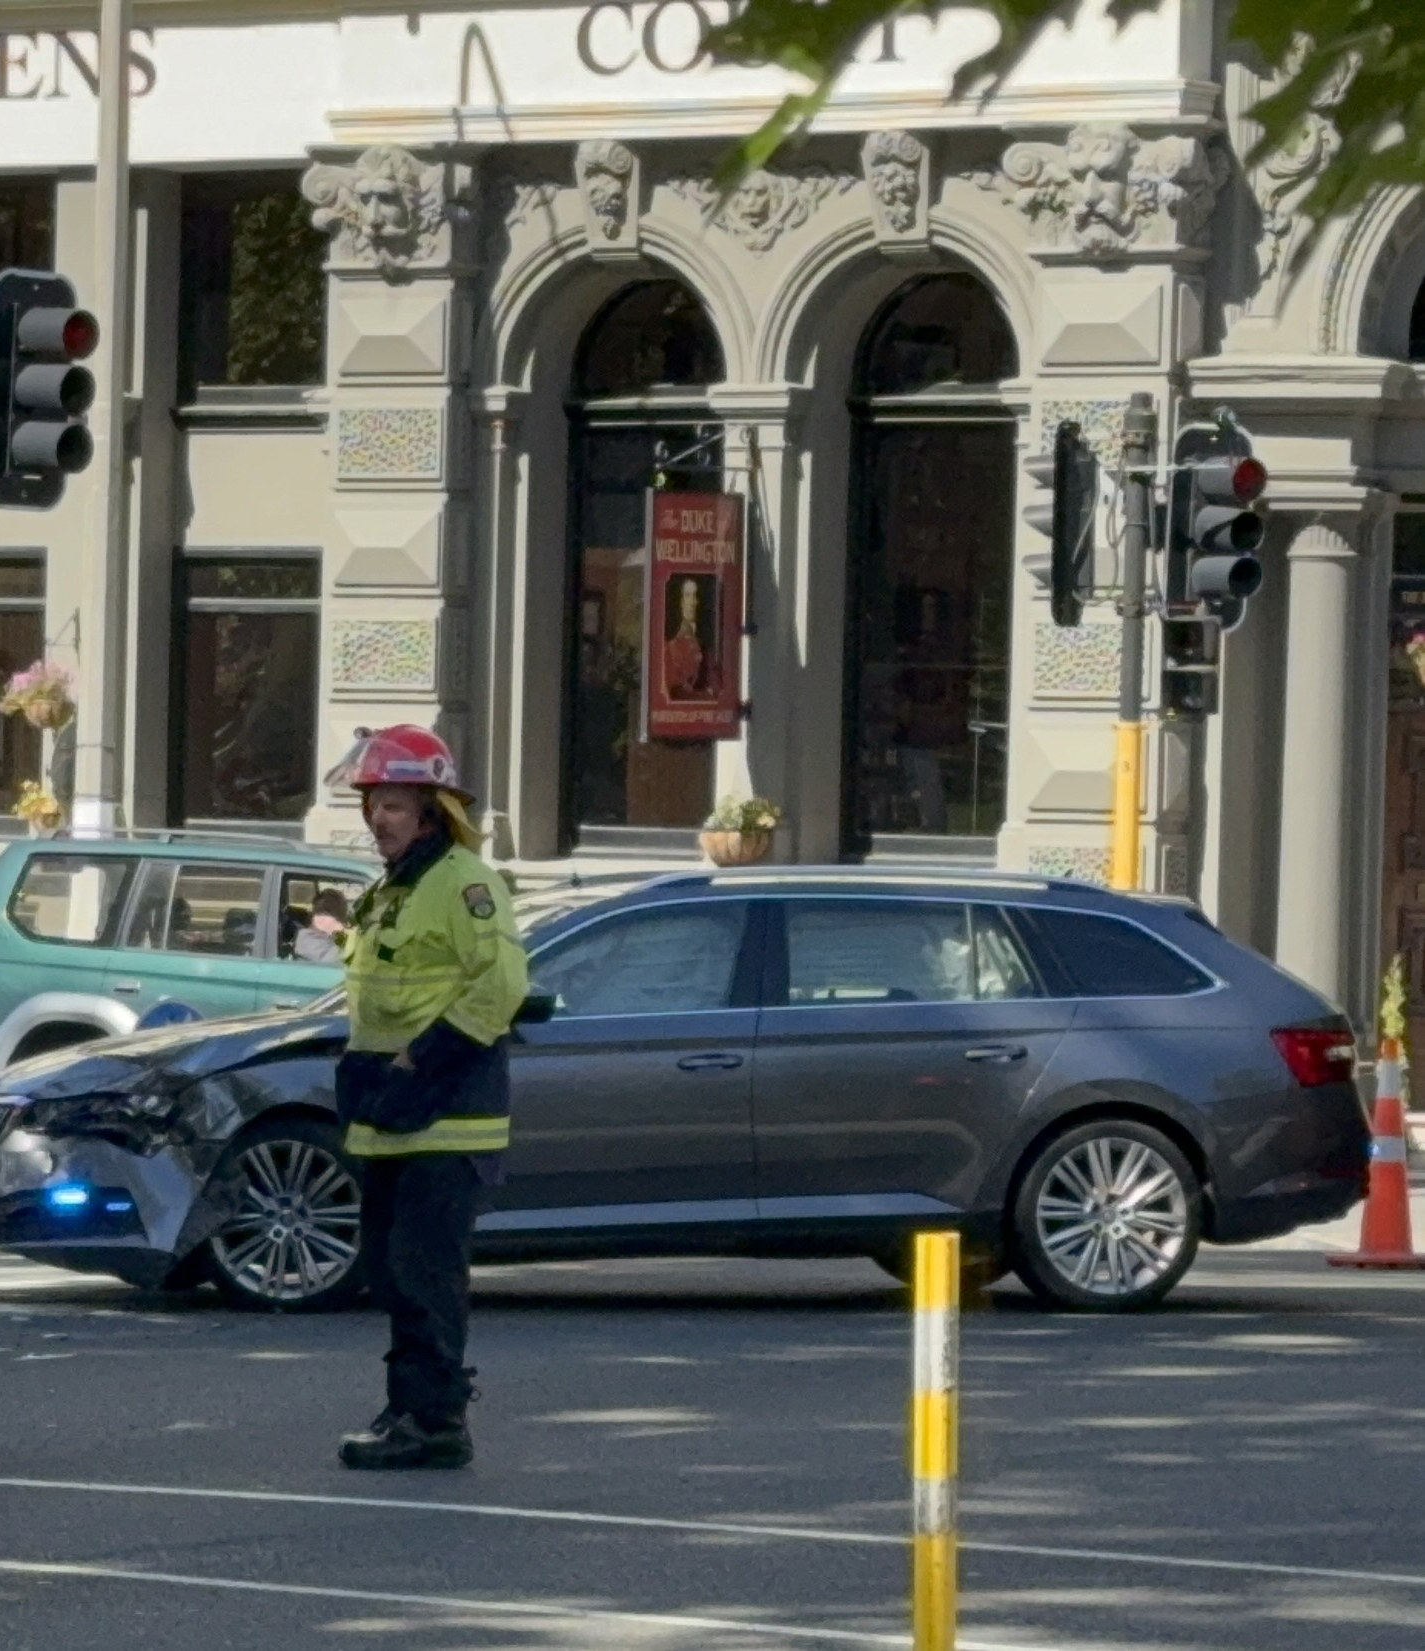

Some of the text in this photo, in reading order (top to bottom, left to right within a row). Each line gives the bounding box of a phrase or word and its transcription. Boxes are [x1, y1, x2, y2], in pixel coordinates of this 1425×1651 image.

[577, 0, 936, 75] COT
[681, 510, 715, 533] DUKE
[655, 538, 736, 564] WELLINGTON
